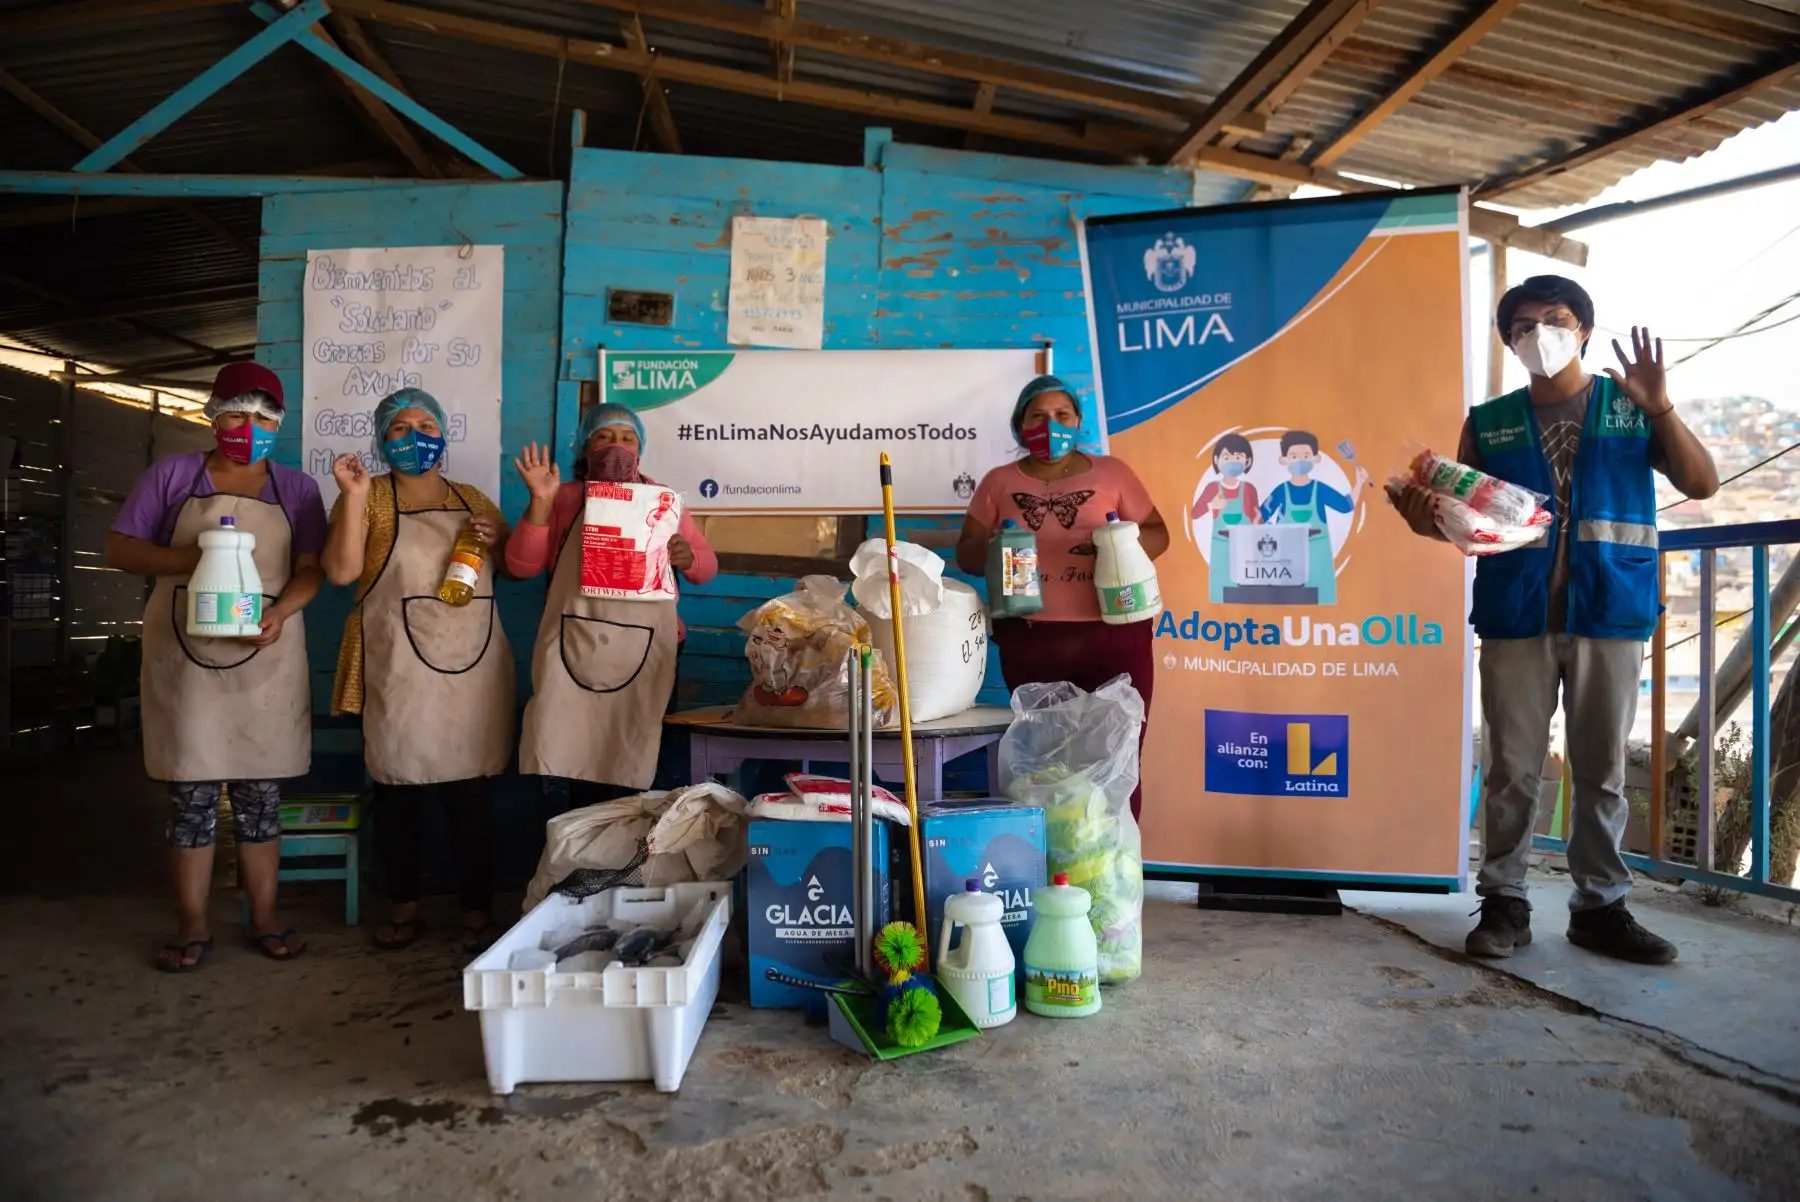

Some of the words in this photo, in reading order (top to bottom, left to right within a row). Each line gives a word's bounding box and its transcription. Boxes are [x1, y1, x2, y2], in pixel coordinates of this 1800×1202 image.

[452, 264, 481, 291] al
[785, 266, 796, 283] 3
[1116, 294, 1211, 313] MUNICIPALIDAD
[1214, 292, 1232, 304] DE
[1118, 312, 1234, 352] LIMA
[313, 337, 386, 363] Gracias
[447, 337, 481, 367] Su
[637, 358, 698, 370] FUNDACIÓN
[637, 370, 697, 390] LIMA
[1605, 418, 1645, 429] LIMA
[677, 423, 977, 445] #EnLimaNosAyudamosTodos
[722, 483, 802, 496] /fundacionlima
[1245, 566, 1293, 580] LIMA
[581, 585, 628, 597] ORTWEST
[1155, 610, 1444, 651] AdoptaUnaOlla
[1183, 655, 1316, 677] MUNICIPALIDAD
[1322, 662, 1347, 677] DE
[1353, 662, 1399, 677] LIMA
[1250, 732, 1268, 745] En
[1217, 742, 1268, 757] alianza
[1237, 758, 1269, 769] con:
[1284, 779, 1340, 792] Latina
[751, 847, 769, 855] SIN
[928, 839, 946, 848] SIN
[765, 904, 854, 925] GLACIA
[1047, 978, 1080, 996] Pino
